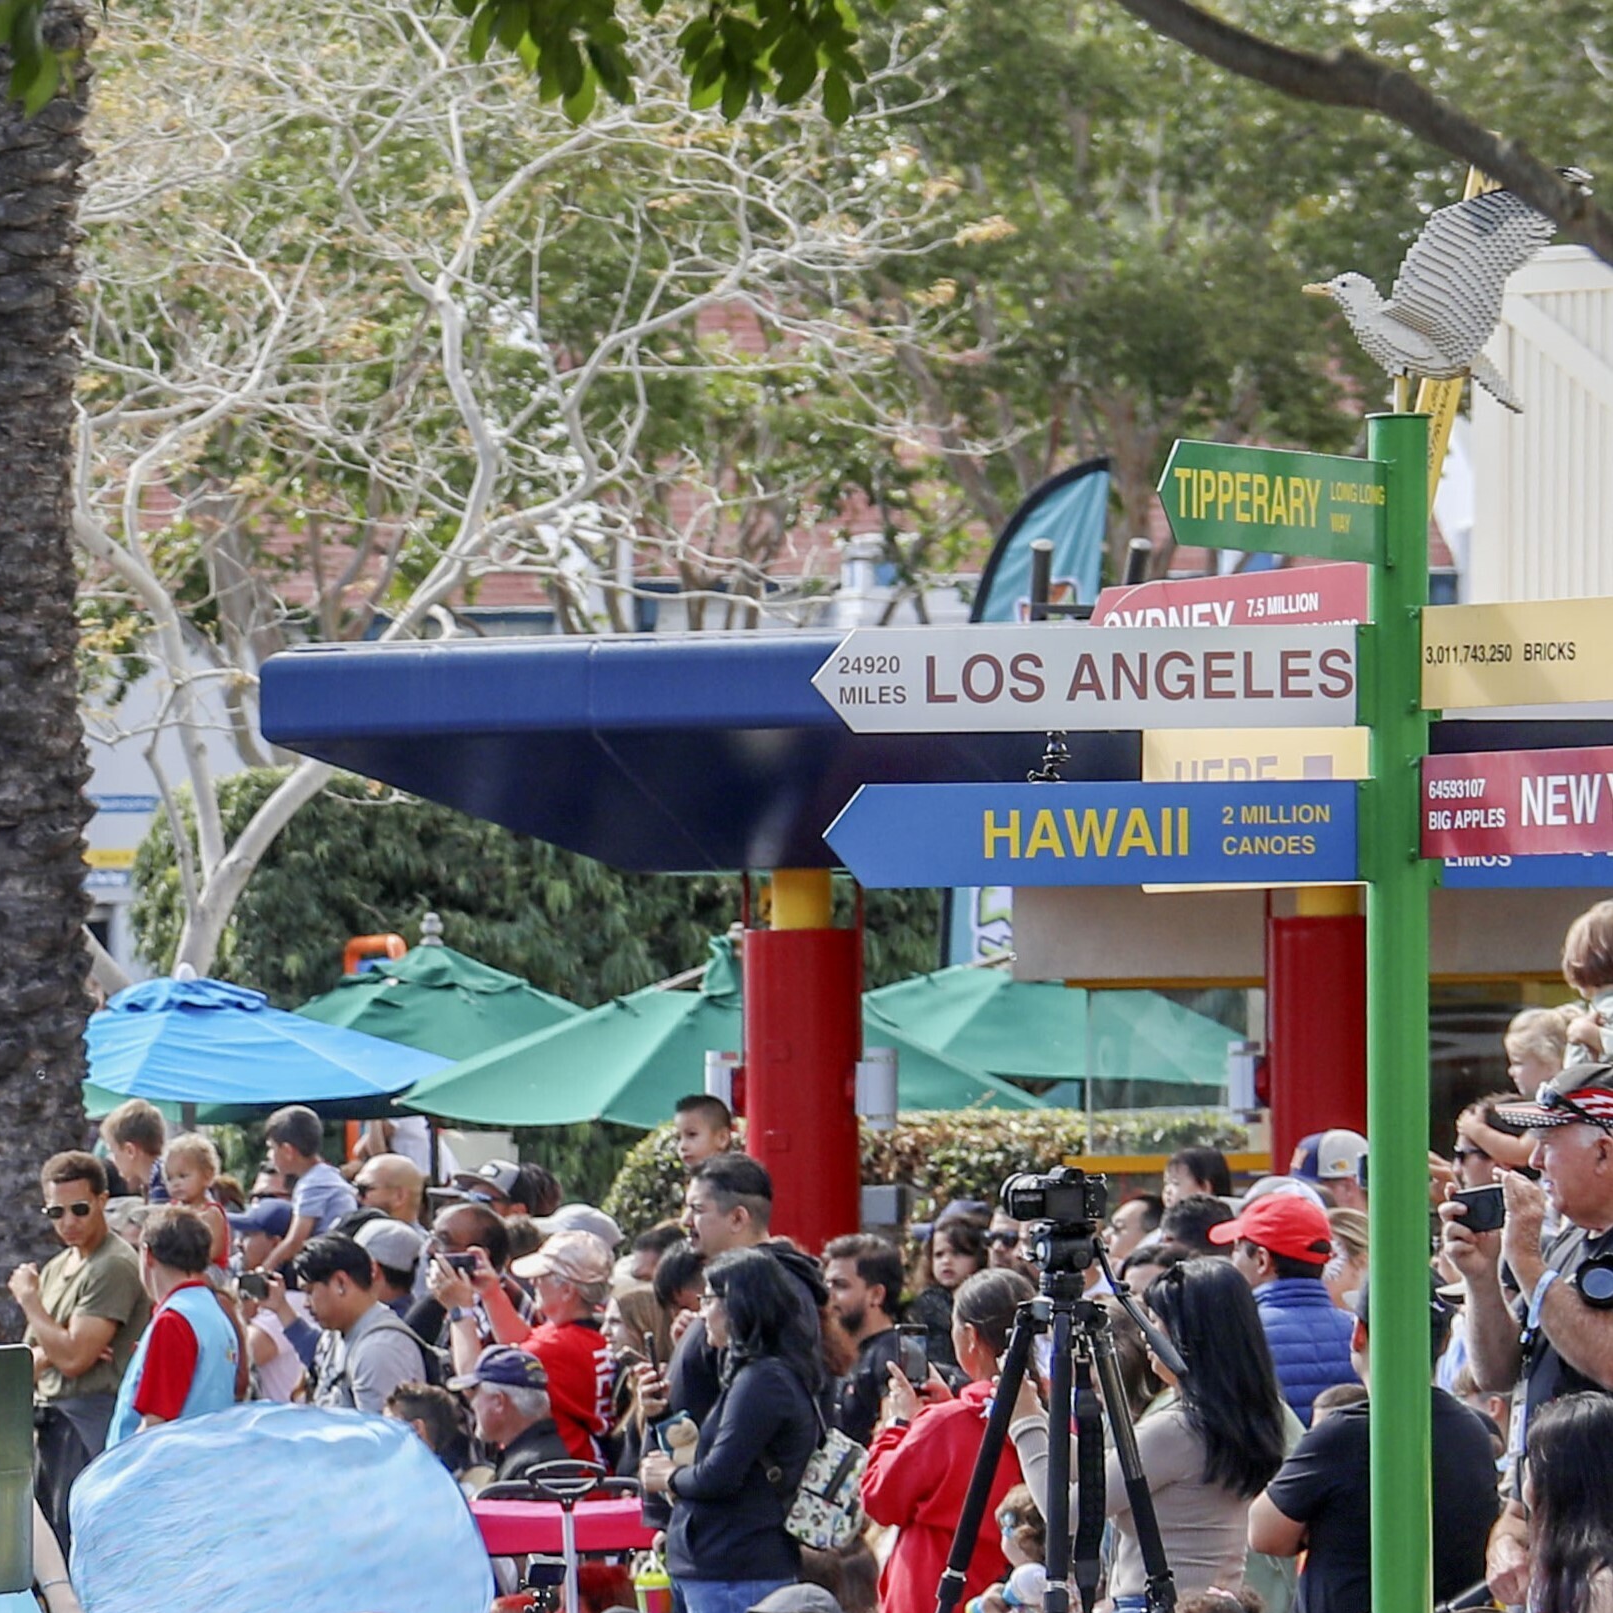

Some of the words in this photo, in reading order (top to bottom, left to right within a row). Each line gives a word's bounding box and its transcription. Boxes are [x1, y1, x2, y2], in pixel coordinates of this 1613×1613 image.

[1173, 466, 1322, 528] TIPPERARY
[1330, 481, 1358, 503] LONG
[1359, 483, 1385, 506] LONG
[1330, 512, 1352, 534] WAY
[1246, 598, 1265, 618] 7.5
[1267, 592, 1319, 616] MILLION
[837, 655, 901, 675] 24920
[1425, 644, 1512, 666] 3,011,743,250
[1523, 641, 1576, 662] BRICKS
[925, 653, 1046, 704] LOS
[1066, 648, 1354, 701] ANGELES
[838, 685, 907, 705] MILES
[1428, 778, 1486, 799] 64593107
[1521, 773, 1602, 827] NEW
[1221, 806, 1233, 825] 2
[1240, 804, 1330, 825] MILLION
[1428, 810, 1451, 831] BIG
[1454, 808, 1506, 829] APPLES
[983, 806, 1189, 859] HAWAII
[1222, 834, 1316, 856] CANOES
